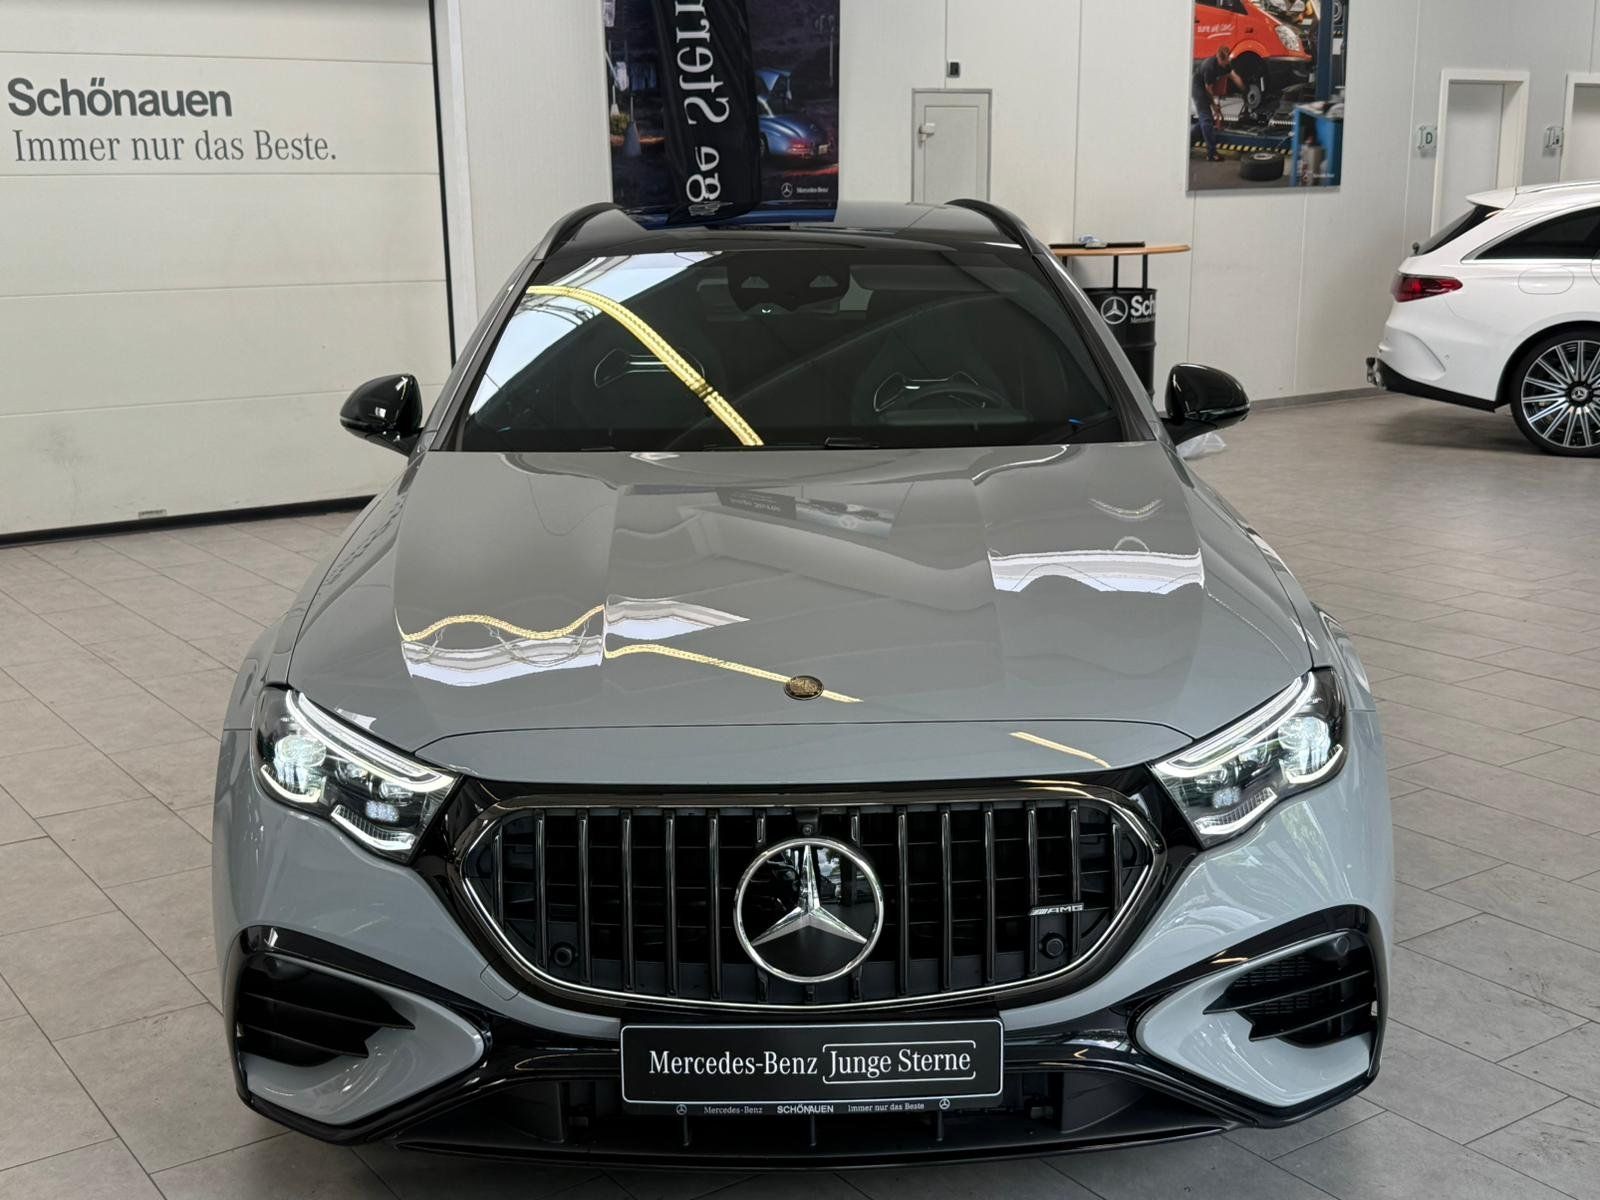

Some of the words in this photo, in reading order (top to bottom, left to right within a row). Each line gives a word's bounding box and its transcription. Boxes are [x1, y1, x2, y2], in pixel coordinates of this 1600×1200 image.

[7, 76, 233, 118] Schönauen
[13, 129, 120, 162] Immer
[131, 134, 185, 161] nur
[195, 130, 245, 161] das
[254, 130, 337, 161] Beste.
[1041, 903, 1084, 915] AMG
[649, 1050, 818, 1075] Mercedes-Benz
[829, 1050, 892, 1078] Junge
[899, 1048, 971, 1073] Sterne
[703, 1104, 763, 1115] Mercedes-Benz
